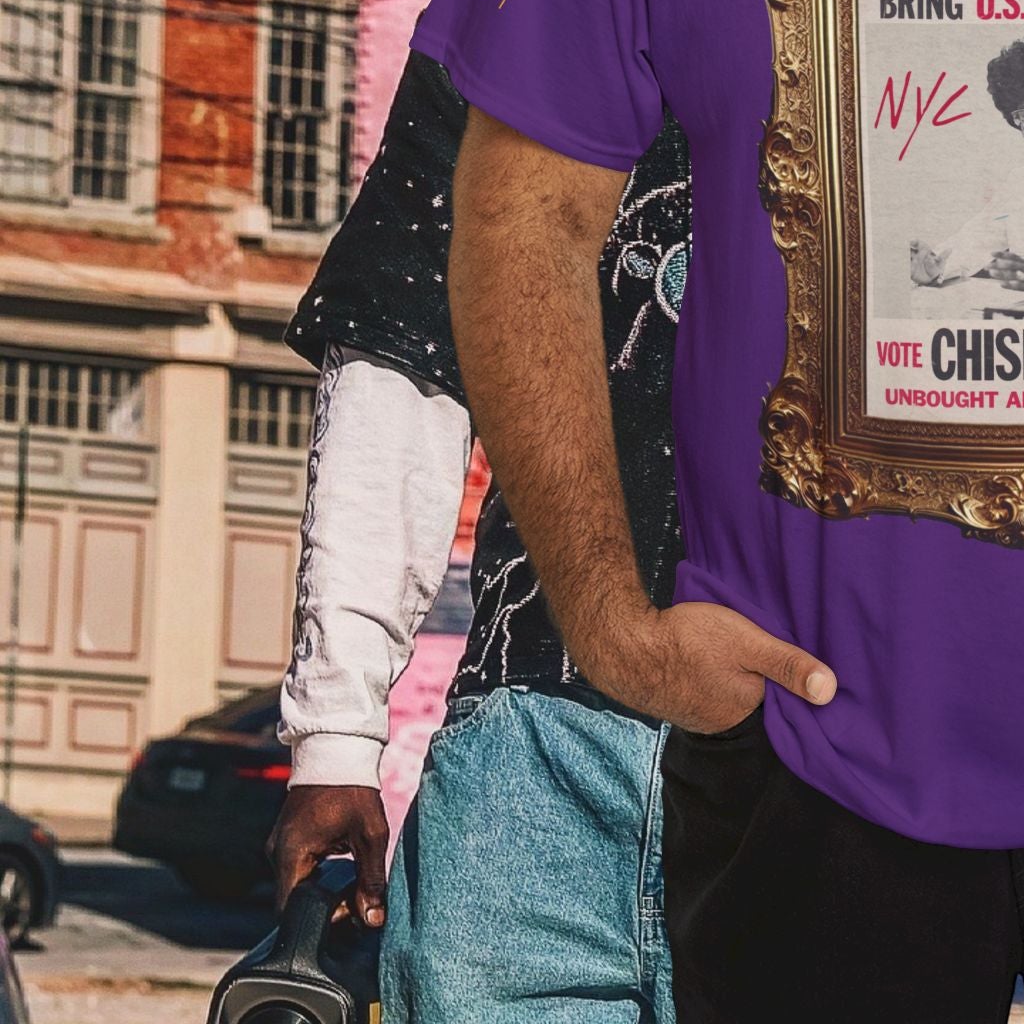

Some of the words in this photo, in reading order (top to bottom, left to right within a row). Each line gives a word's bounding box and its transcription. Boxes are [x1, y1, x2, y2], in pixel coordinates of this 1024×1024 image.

[874, 70, 972, 161] NYC
[876, 341, 923, 368] VOTE
[884, 388, 998, 409] UNBOUGHT
